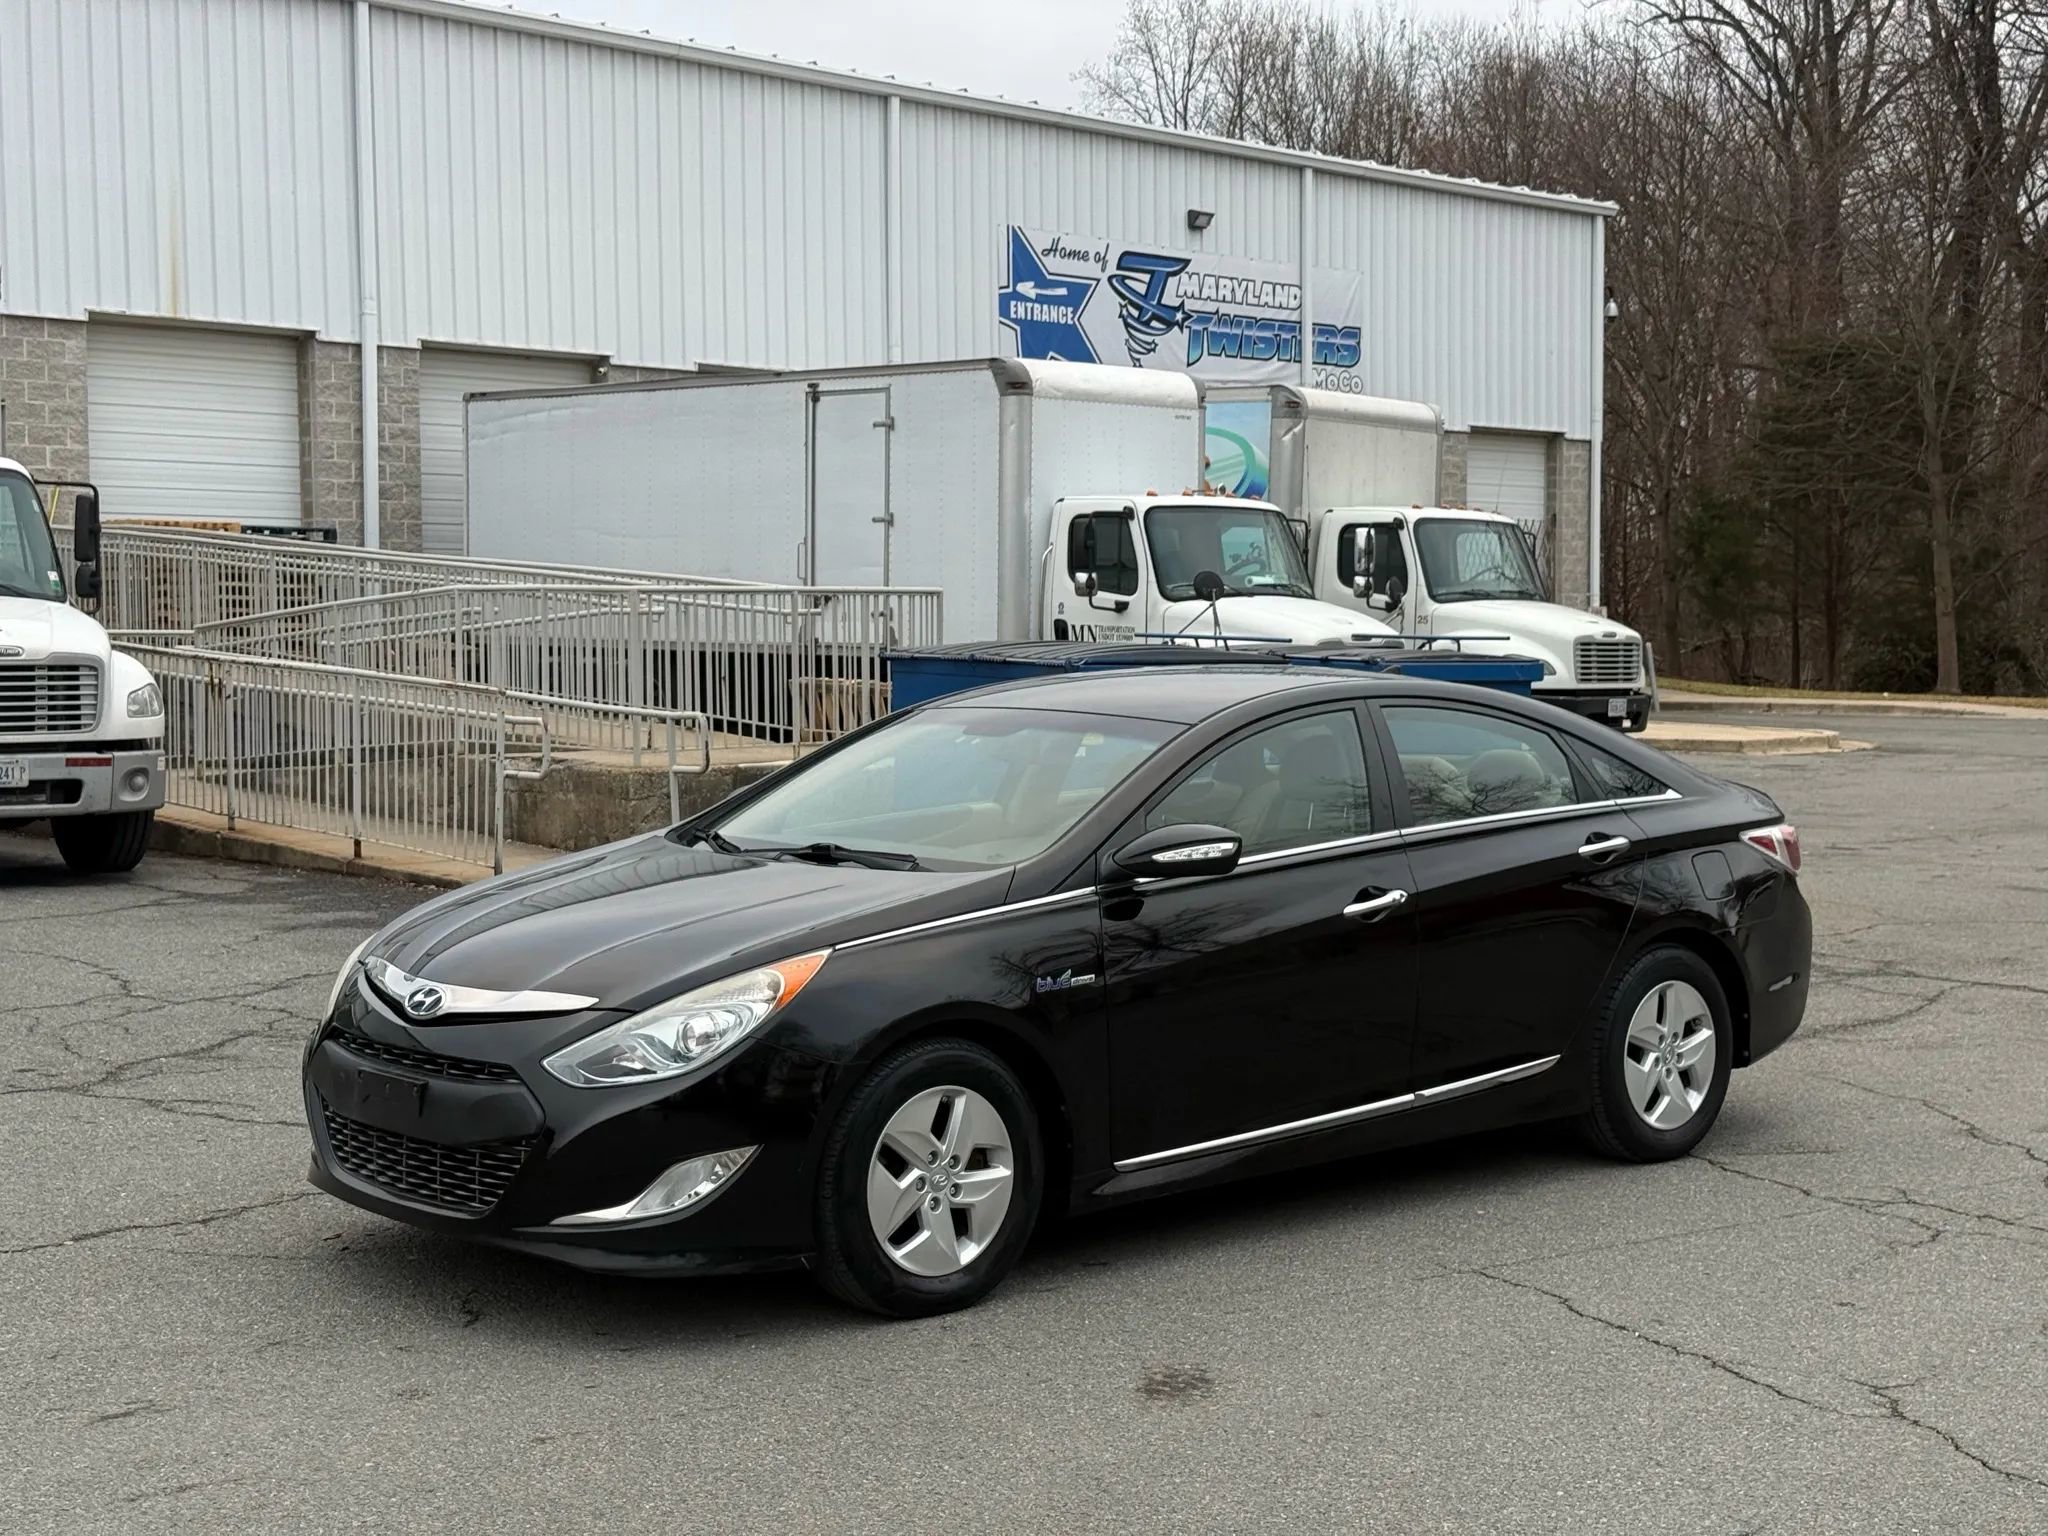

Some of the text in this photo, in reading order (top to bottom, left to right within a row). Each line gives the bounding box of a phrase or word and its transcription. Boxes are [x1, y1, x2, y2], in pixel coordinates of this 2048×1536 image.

[1041, 236, 1109, 273] Home of
[1176, 271, 1302, 311] MARYLAND
[1009, 300, 1074, 325] ENTRANCE
[1311, 367, 1364, 395] MoCo
[1037, 975, 1071, 993] blue
